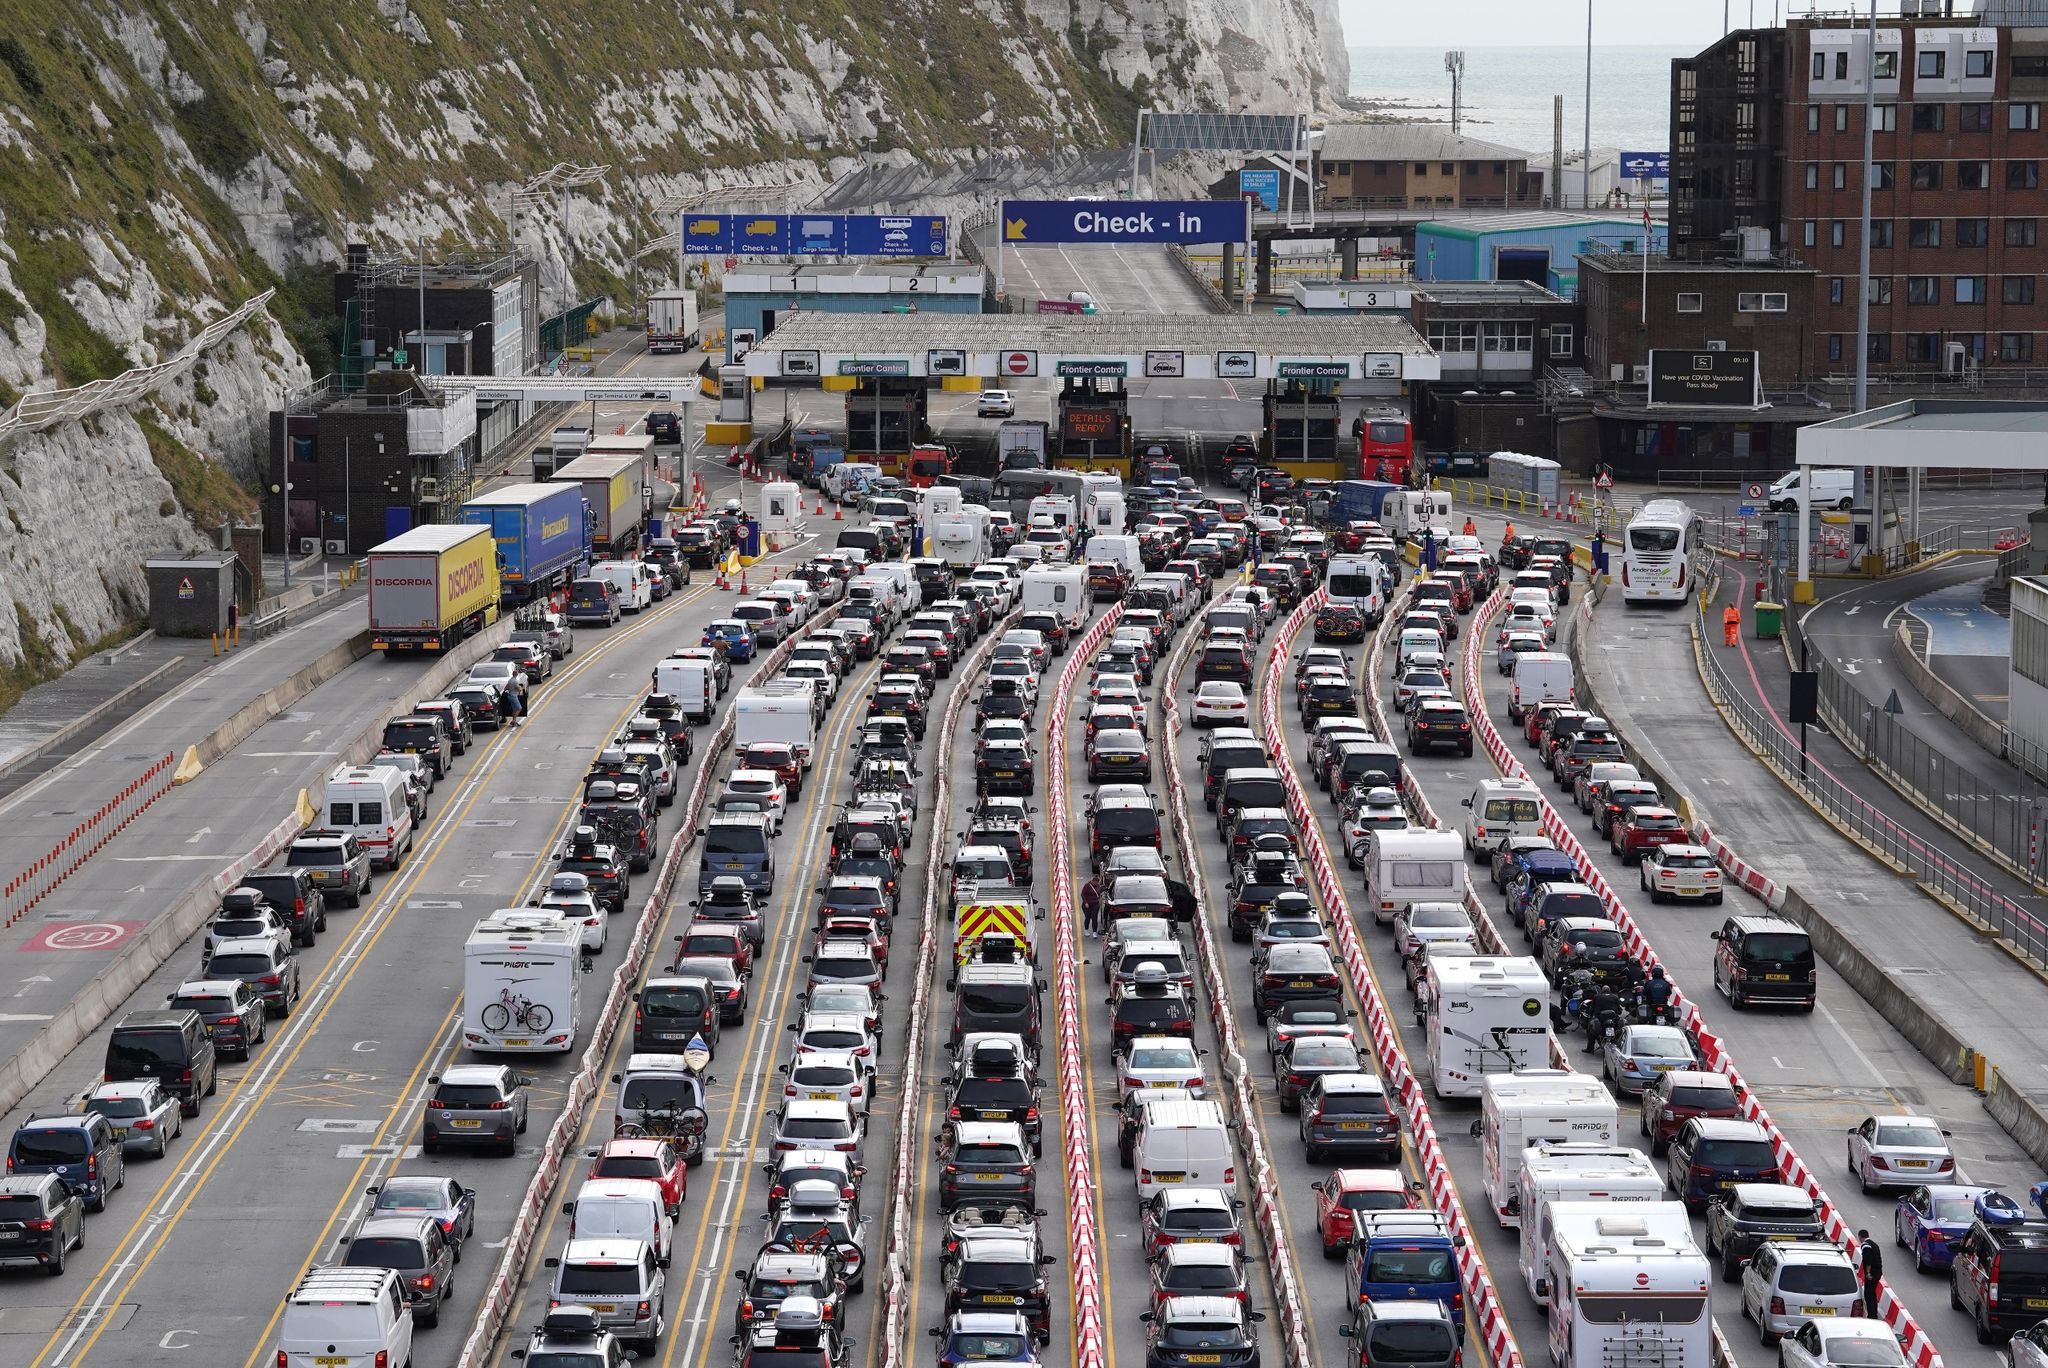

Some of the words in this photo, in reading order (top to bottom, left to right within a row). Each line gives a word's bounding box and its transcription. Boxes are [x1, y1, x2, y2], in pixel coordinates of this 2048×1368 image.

[1074, 211, 1155, 233] Check
[1179, 211, 1201, 233] in
[686, 244, 709, 252] Check
[790, 278, 798, 290] 1
[909, 278, 918, 291] 2
[1367, 293, 1377, 305] 3
[842, 364, 875, 373] Frontier
[876, 364, 907, 373] Control
[1060, 365, 1093, 374] Frontier
[1094, 365, 1125, 374] Control
[1282, 367, 1314, 375] Frontier
[1316, 367, 1347, 375] Control
[1069, 414, 1112, 422] DETAILS
[1075, 424, 1105, 432] READY
[375, 578, 433, 586] DISCORDIA
[448, 556, 485, 602] DISCORDIA
[57, 931, 111, 943] 20
[504, 961, 531, 969] PILOTE
[1571, 1122, 1602, 1130] RAPIDO
